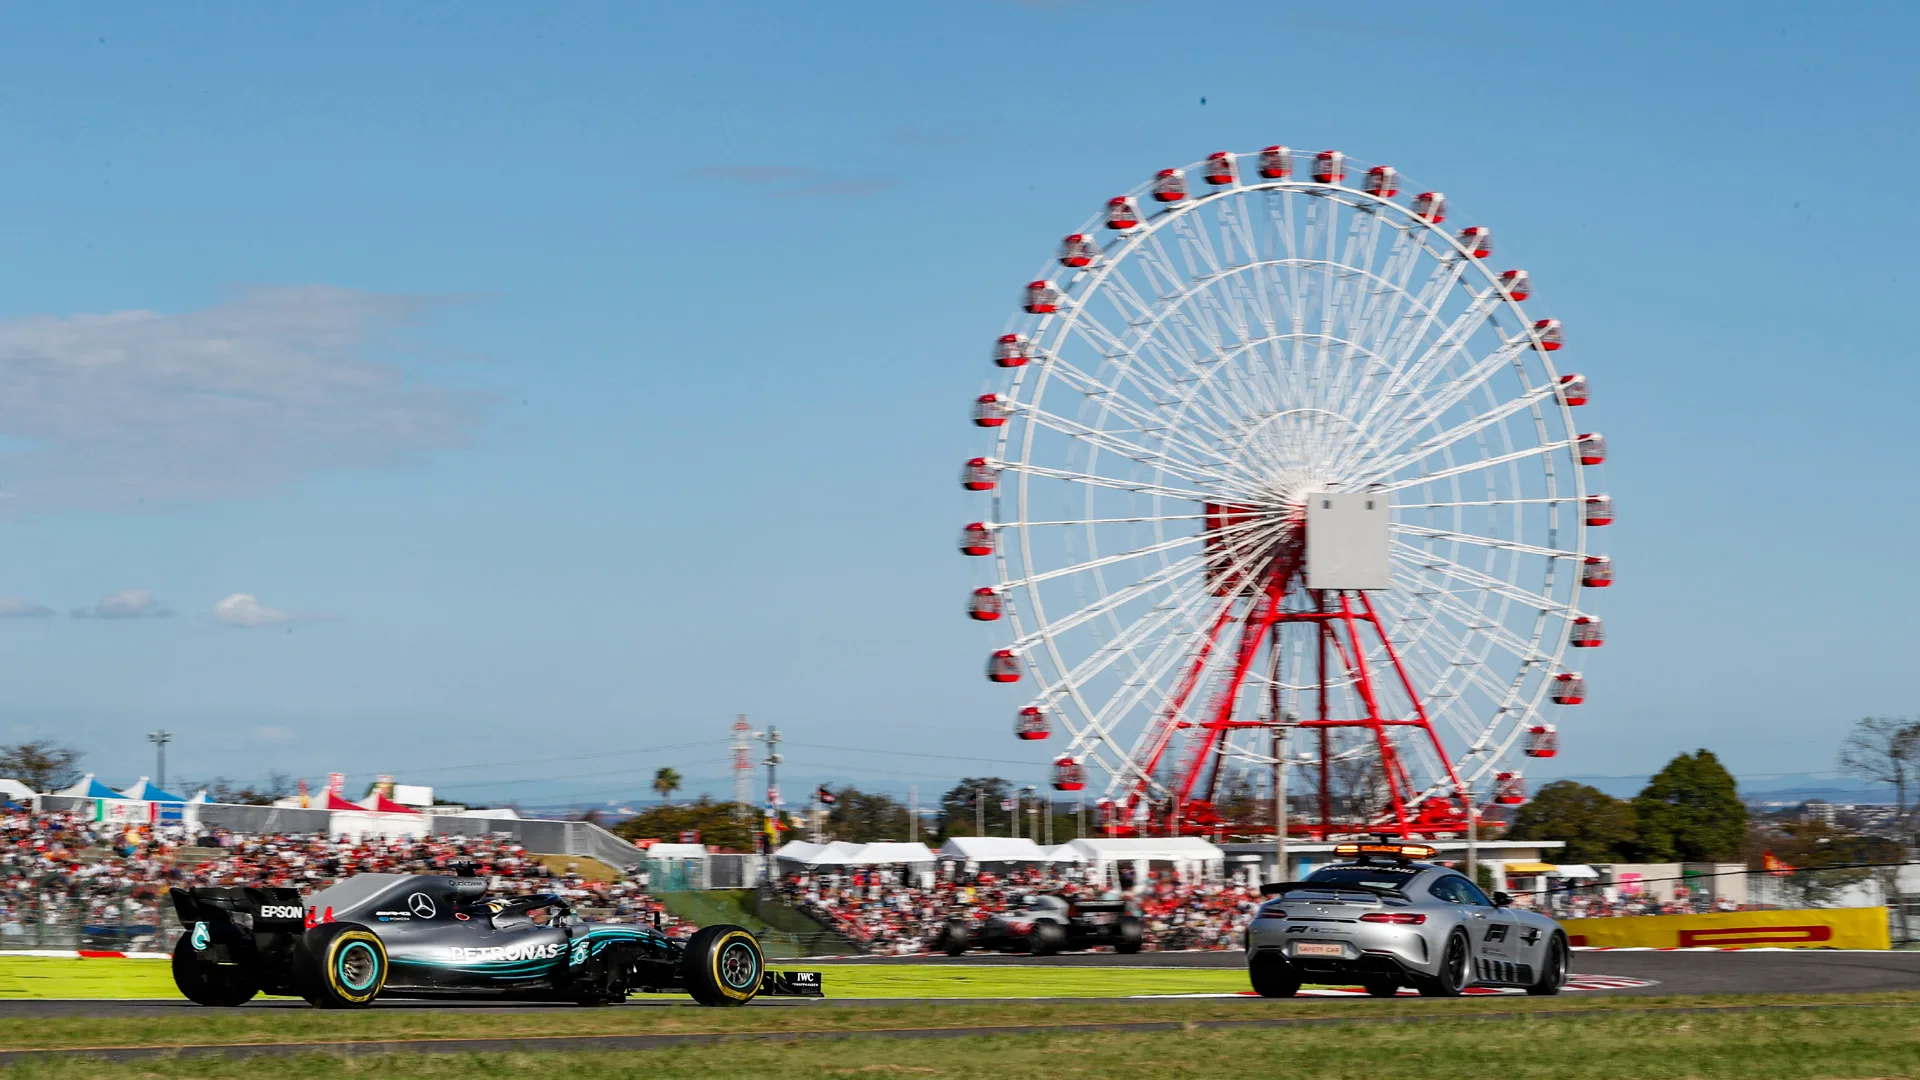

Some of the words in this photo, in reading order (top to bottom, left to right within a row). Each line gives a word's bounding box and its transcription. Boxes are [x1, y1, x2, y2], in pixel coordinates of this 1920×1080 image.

[261, 905, 303, 919] EPSON
[450, 943, 559, 961] PETRONAS
[1299, 945, 1324, 953] SAFETY
[1326, 946, 1340, 954] CAR
[797, 972, 815, 982] IWC
